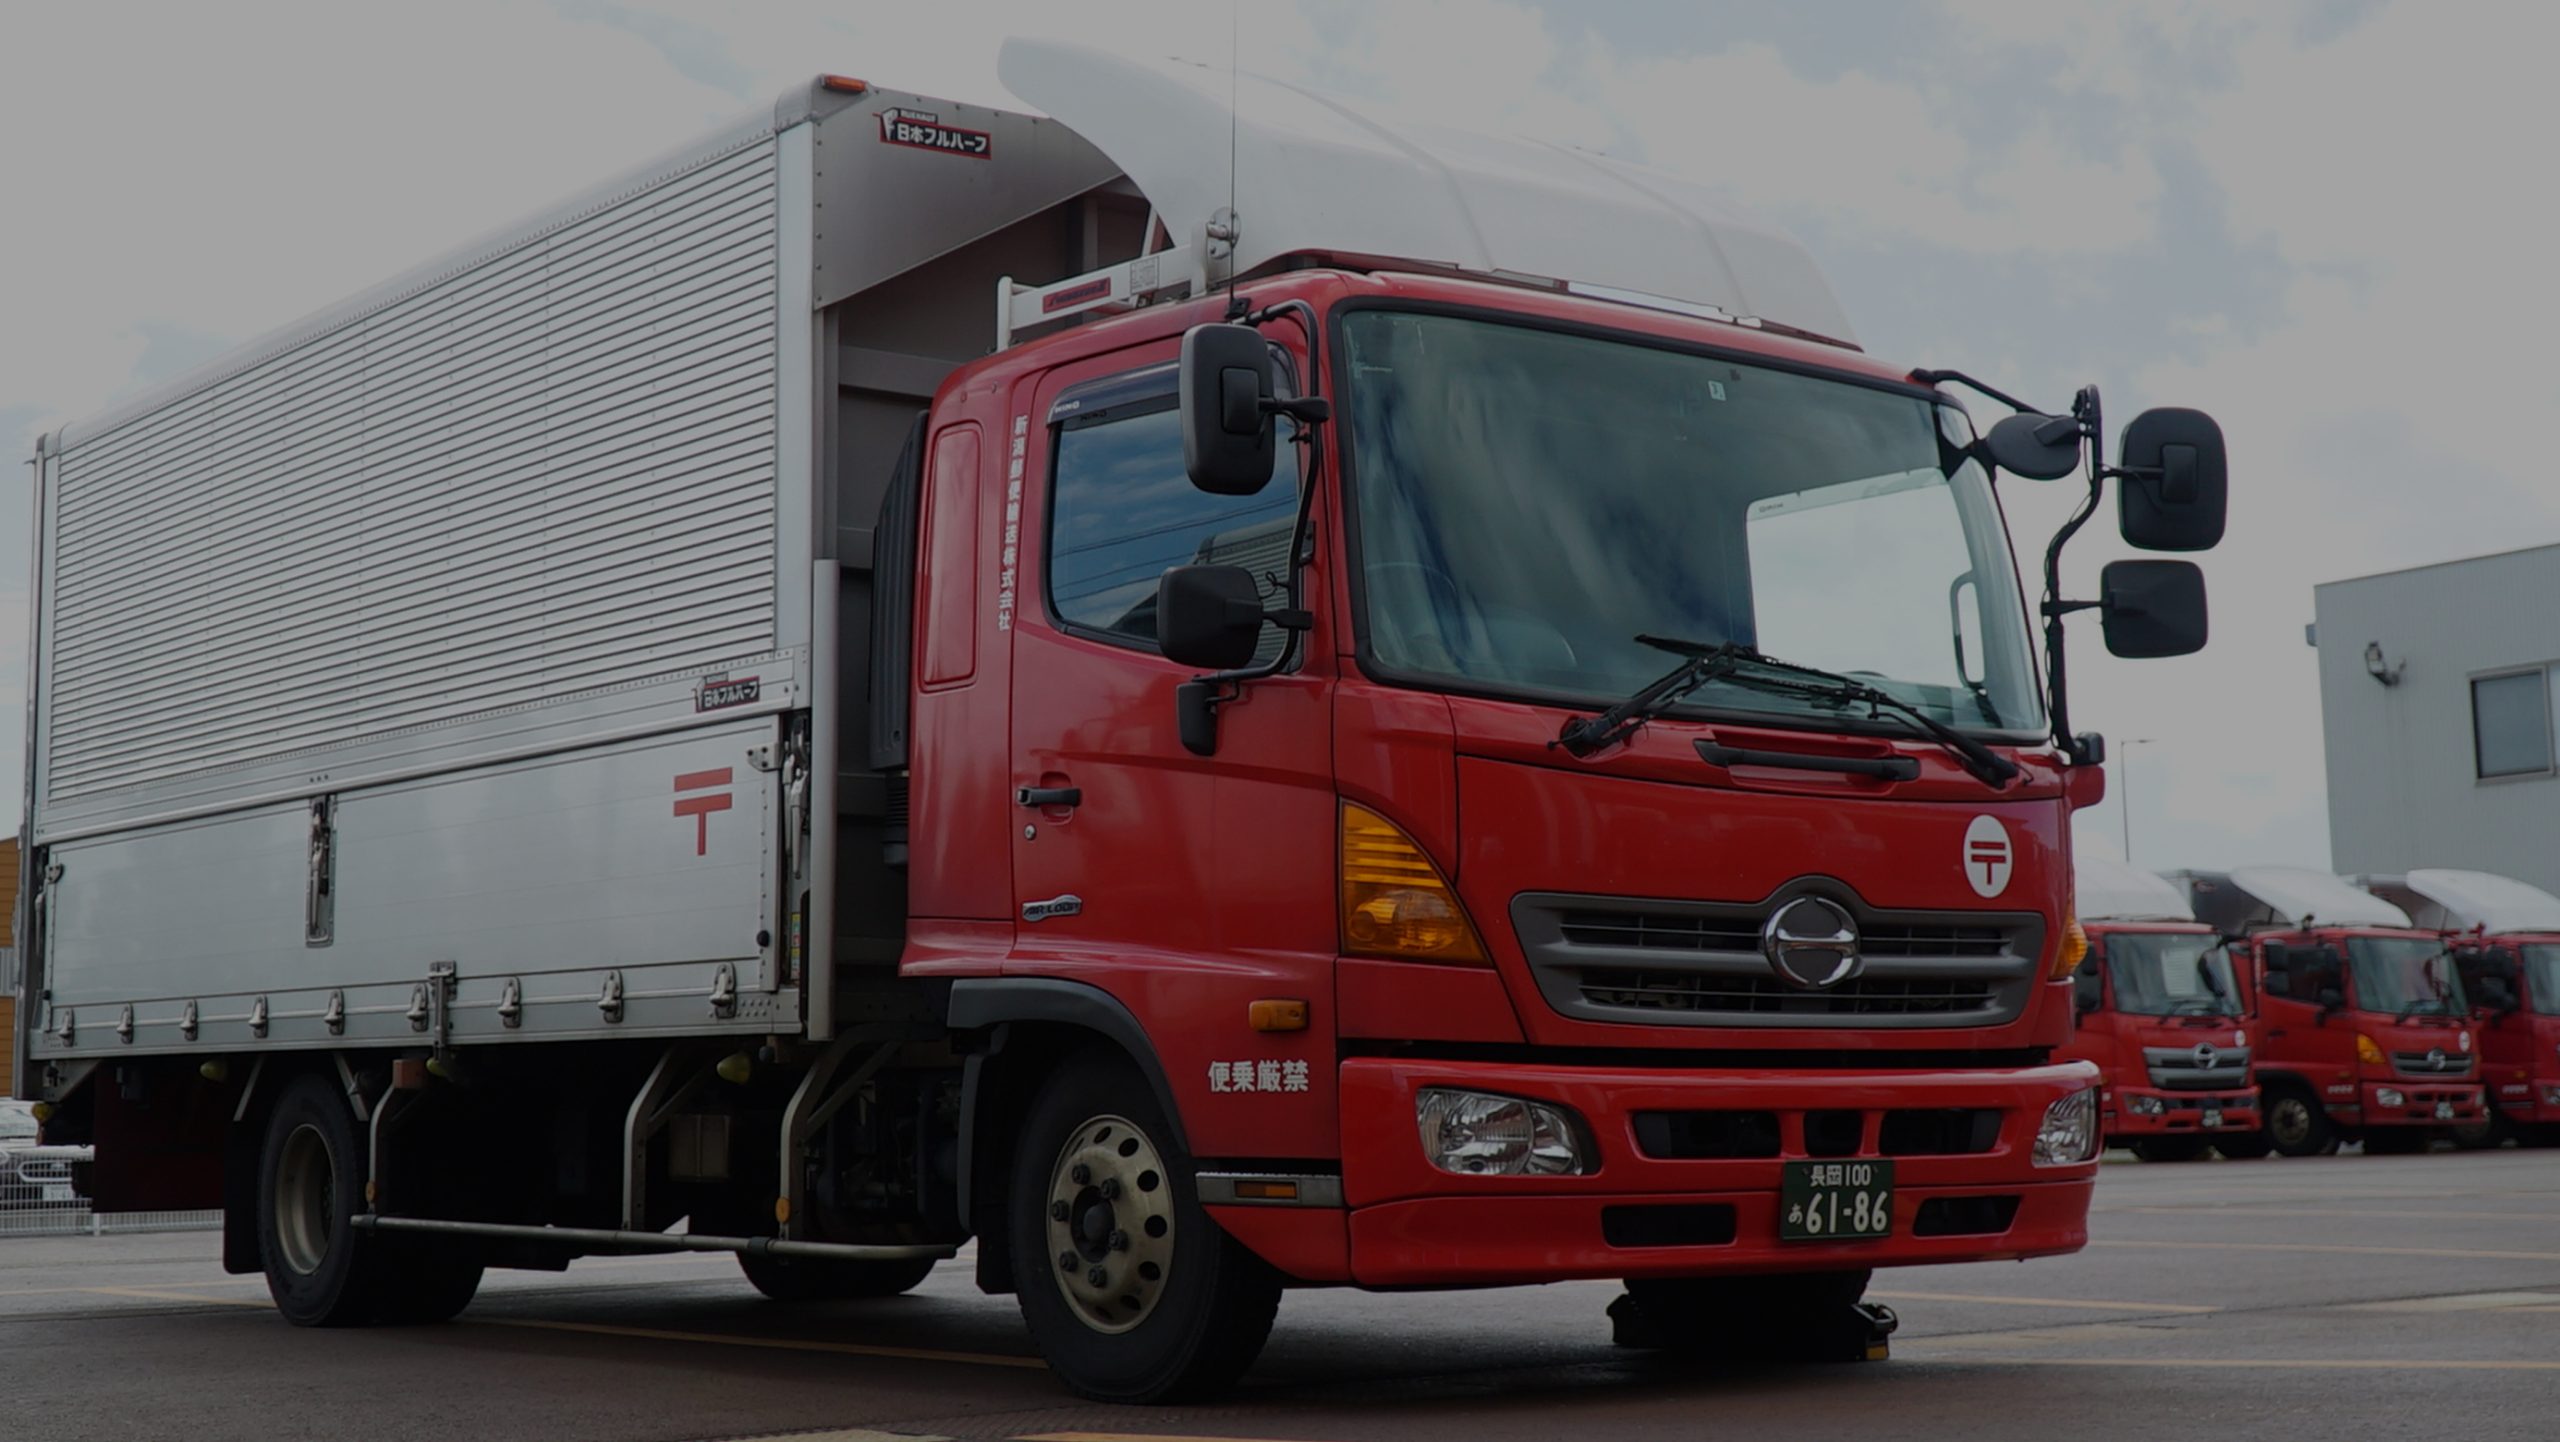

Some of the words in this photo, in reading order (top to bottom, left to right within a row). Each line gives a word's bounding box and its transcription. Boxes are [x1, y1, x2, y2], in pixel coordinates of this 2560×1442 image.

[897, 122, 987, 153] 日本フルハーフ
[704, 681, 758, 708] 日本フルハーフ
[1207, 1059, 1309, 1093] 便乗厳禁
[1805, 1190, 1888, 1234] 61-86
